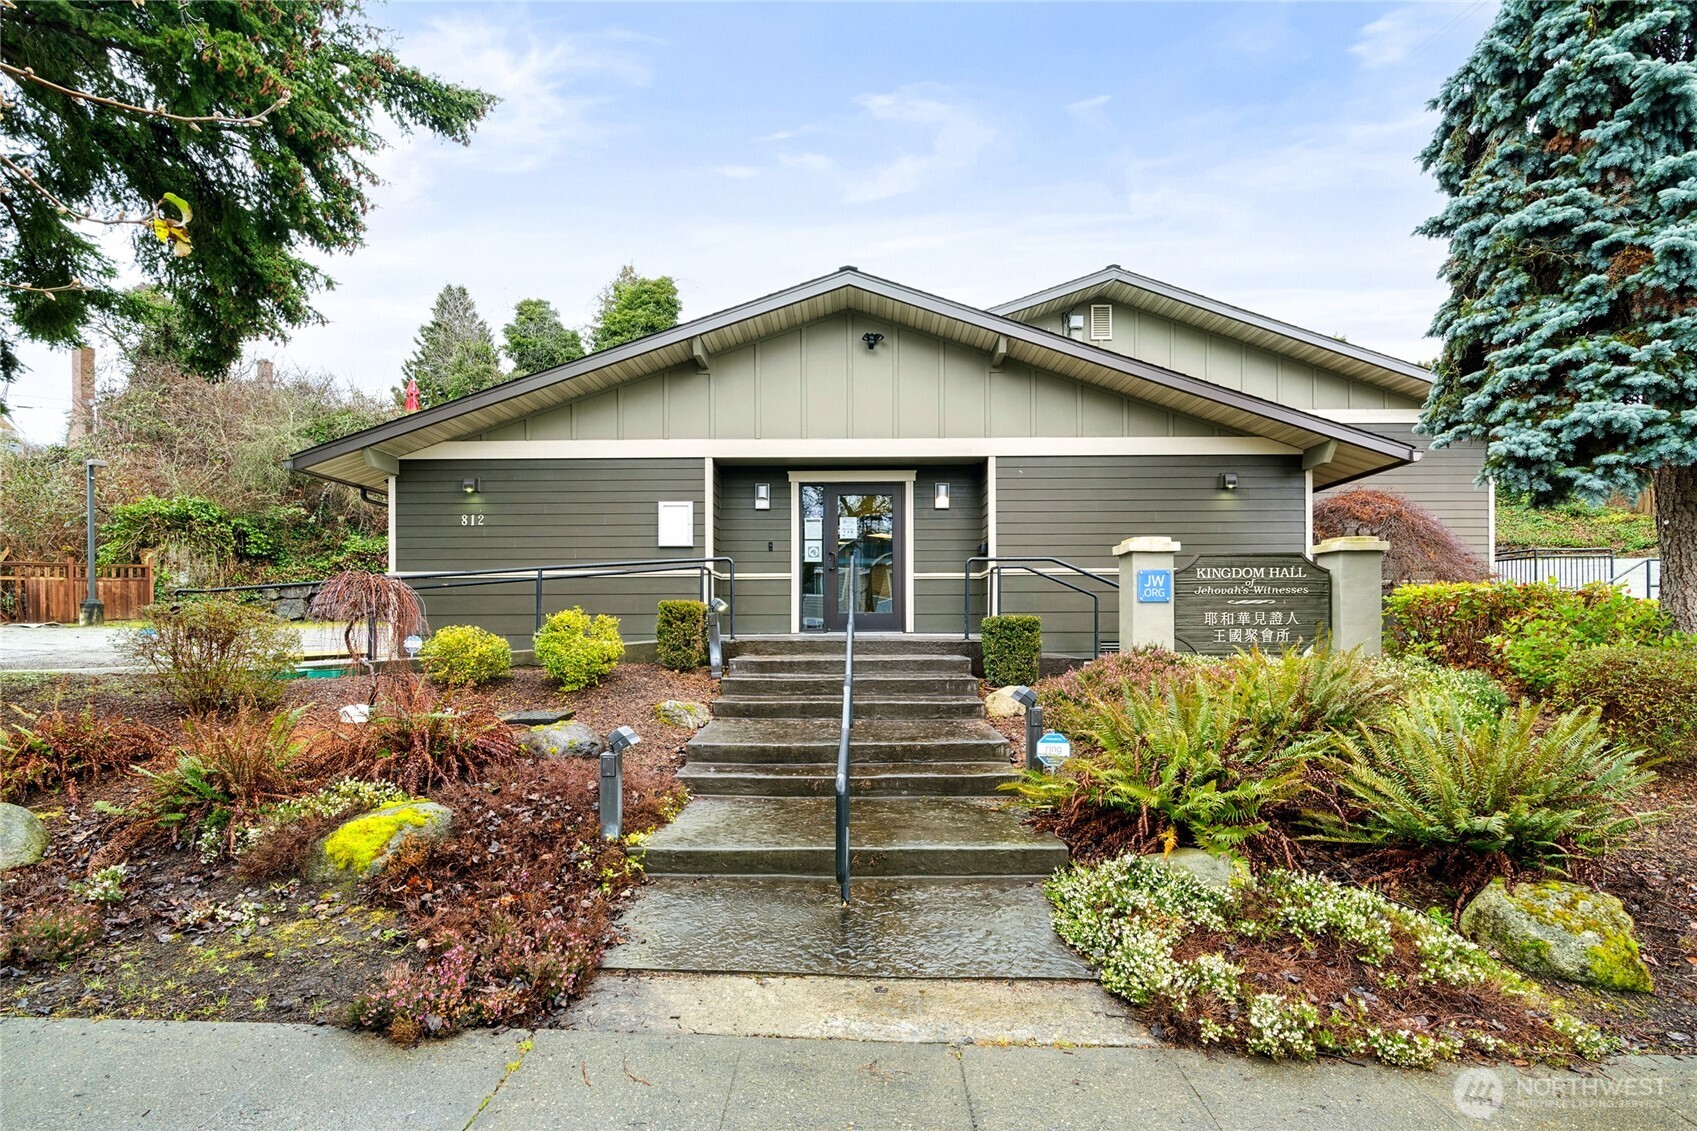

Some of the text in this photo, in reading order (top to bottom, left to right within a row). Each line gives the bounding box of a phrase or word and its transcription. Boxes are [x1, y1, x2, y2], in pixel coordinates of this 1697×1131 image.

[461, 514, 484, 526] 812
[1196, 567, 1307, 579] KINGDOM HALL
[1144, 574, 1165, 587] JW
[1245, 578, 1255, 588] of
[1142, 587, 1166, 598] .ORG
[1194, 585, 1309, 595] Jehovah's Witnesses
[1204, 611, 1300, 626] 耶和華見證人
[1213, 628, 1291, 643] 王國聚會所
[1046, 745, 1062, 754] ring
